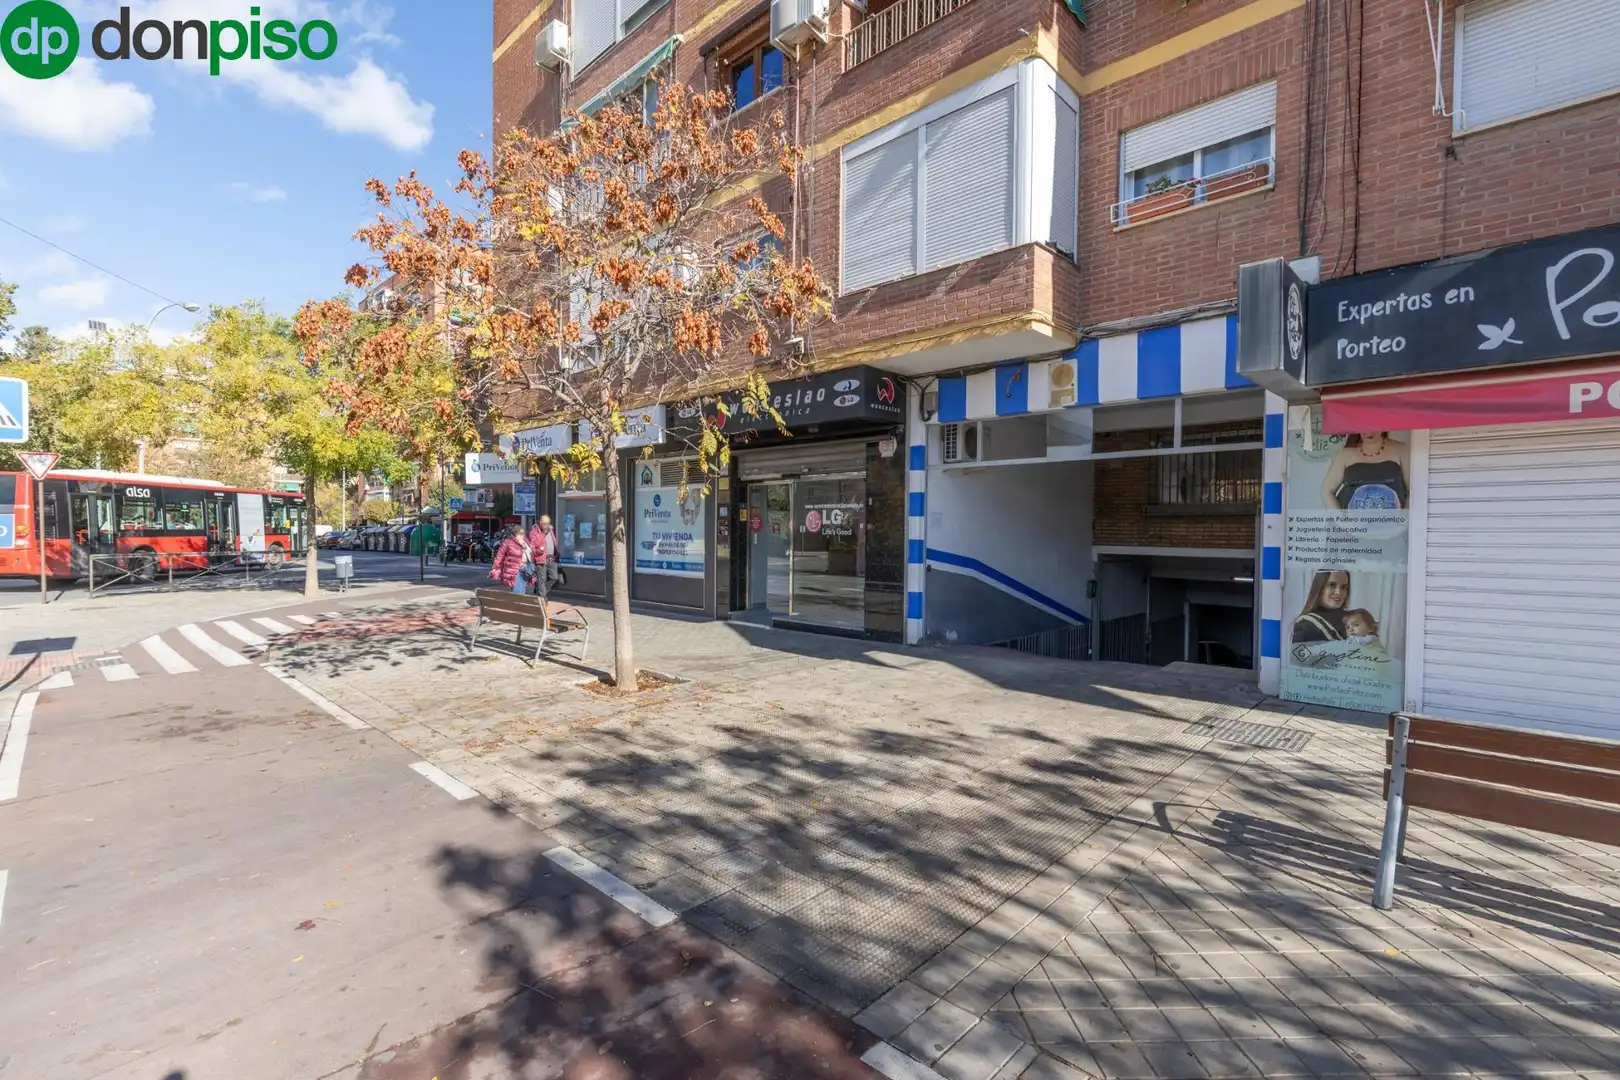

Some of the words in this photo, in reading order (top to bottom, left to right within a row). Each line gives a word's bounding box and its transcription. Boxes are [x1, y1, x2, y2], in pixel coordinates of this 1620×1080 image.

[1338, 292, 1432, 325] Expertas
[1444, 286, 1475, 305] en
[1337, 336, 1406, 360] Porteo
[730, 388, 826, 415] weslao
[126, 486, 151, 498] alsa
[644, 508, 672, 518] PriVenta
[822, 509, 842, 525] LG
[1296, 516, 1324, 524] Expertas
[1360, 515, 1406, 524] ergonómico
[652, 532, 661, 541] TU
[661, 532, 694, 541] VIVENDA
[836, 528, 852, 536] Good
[1340, 547, 1383, 555] maternidad
[1295, 556, 1321, 564] Regalos
[1322, 557, 1357, 565] originales
